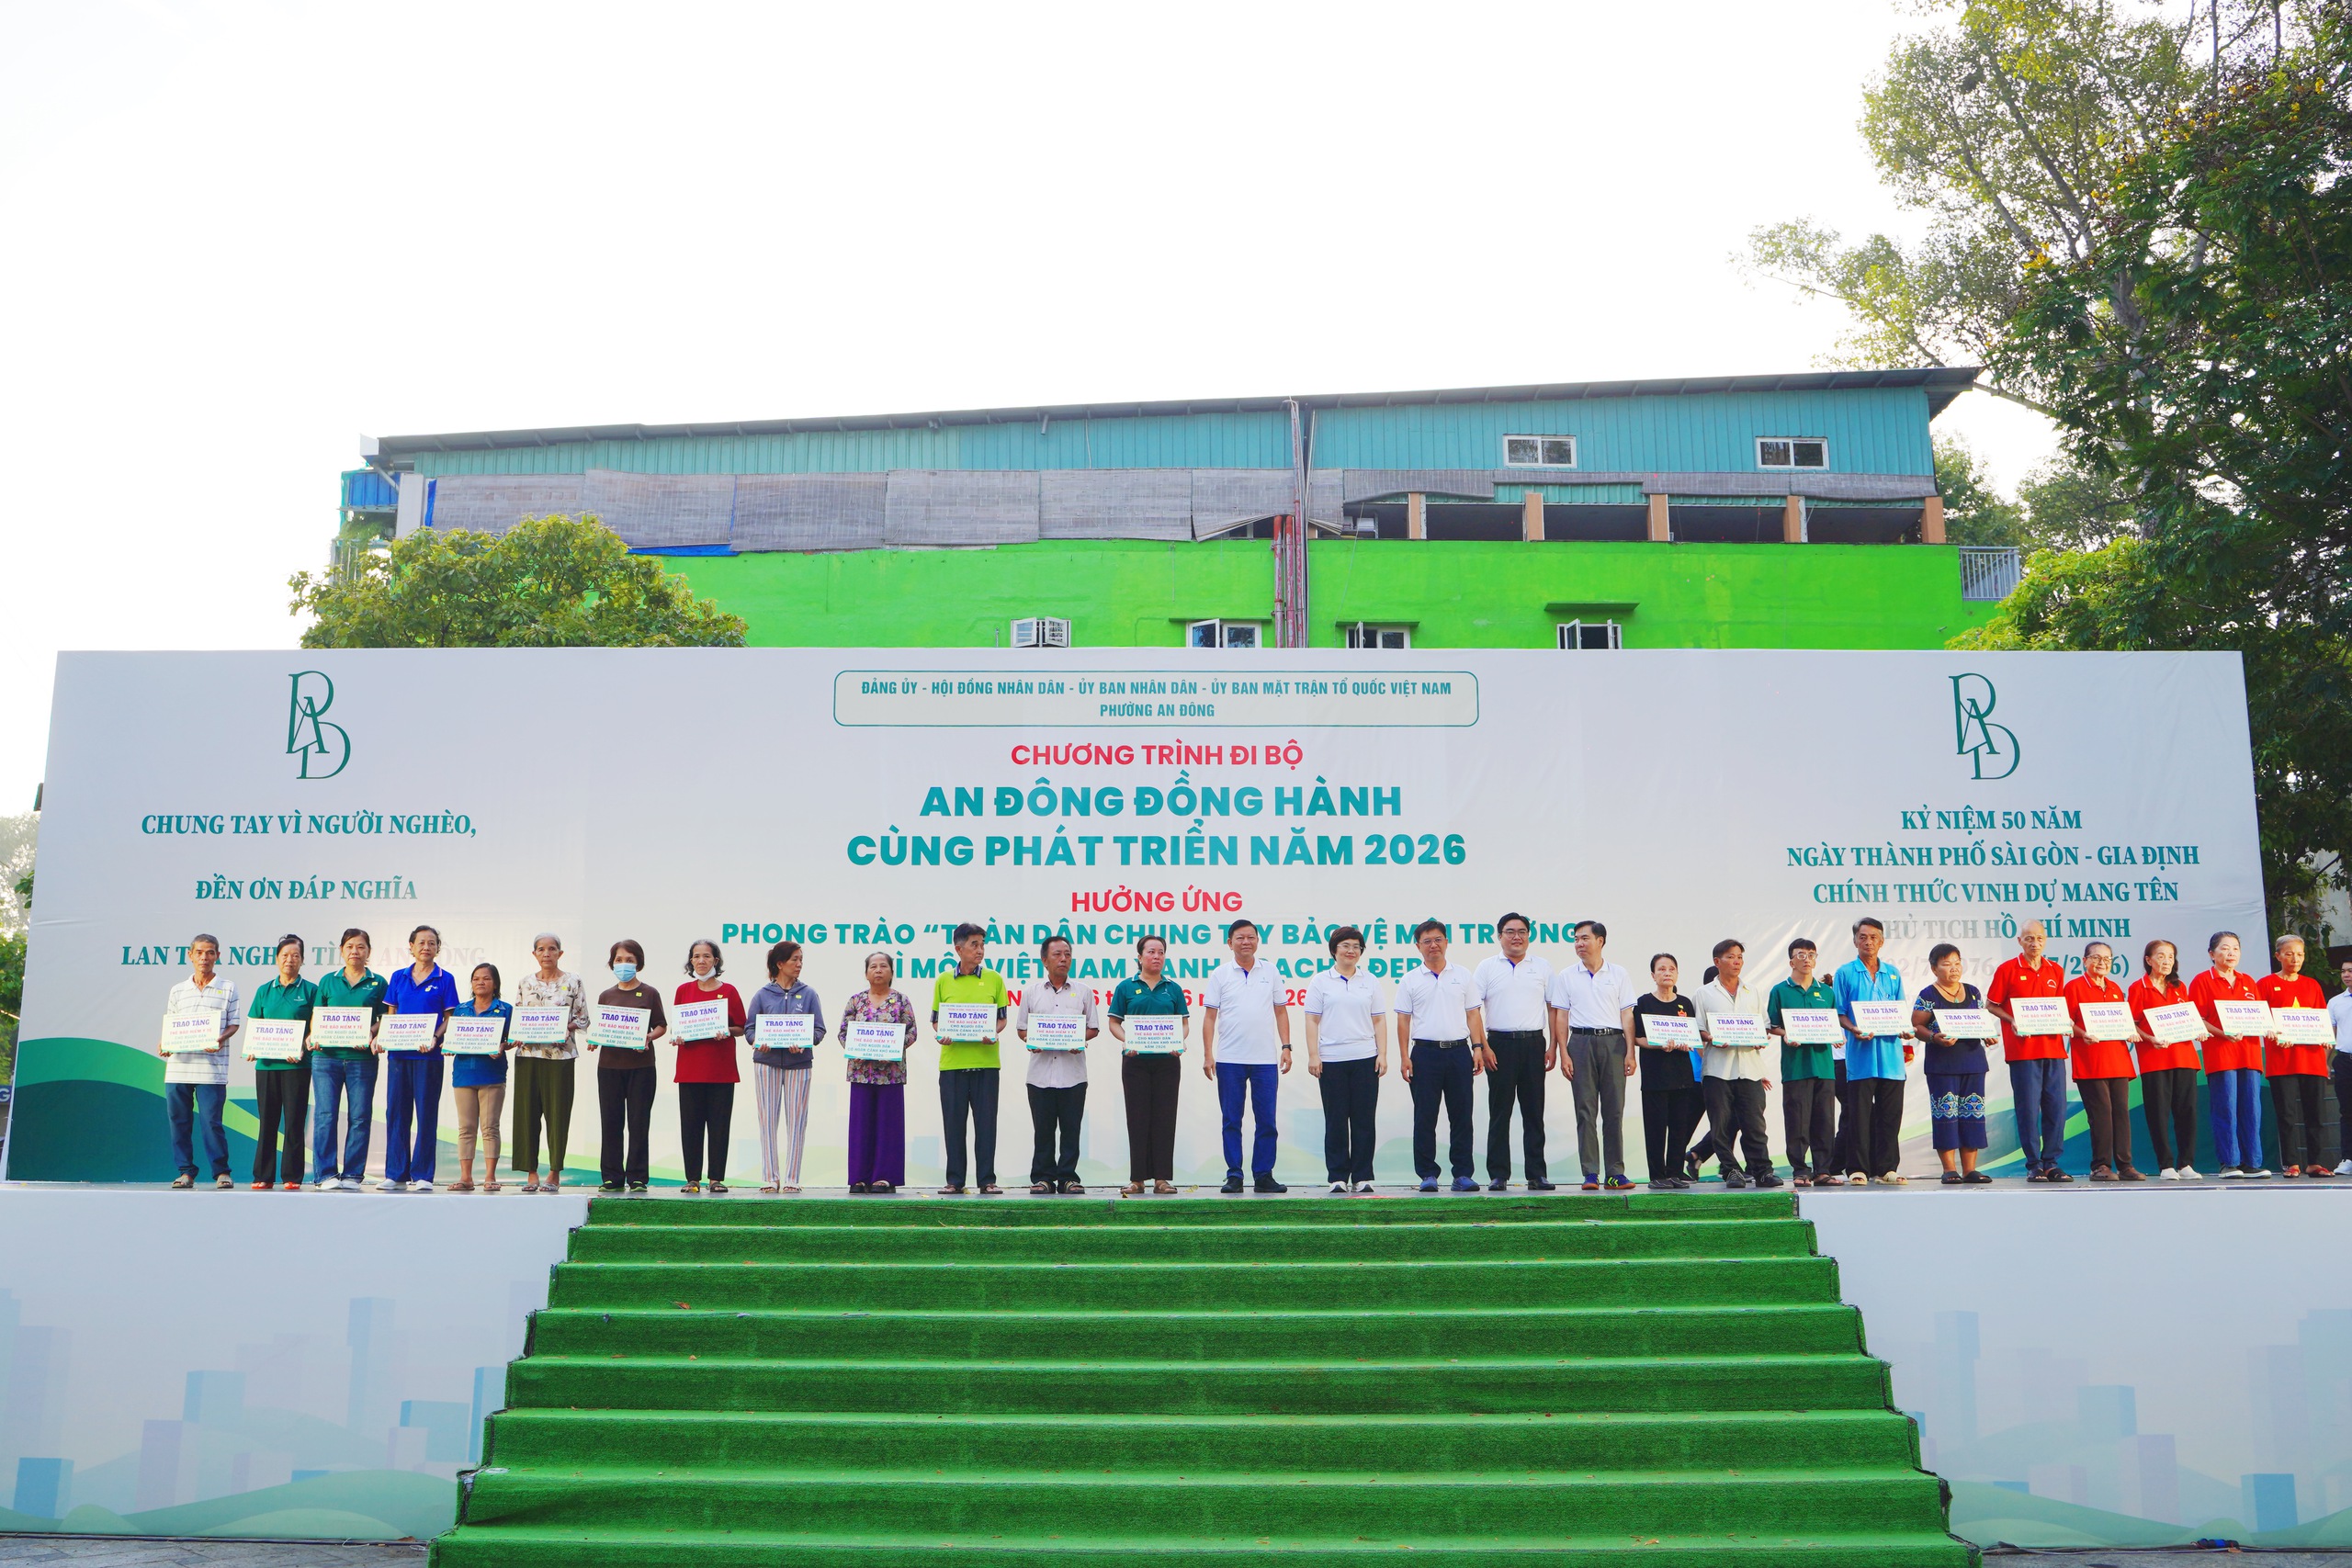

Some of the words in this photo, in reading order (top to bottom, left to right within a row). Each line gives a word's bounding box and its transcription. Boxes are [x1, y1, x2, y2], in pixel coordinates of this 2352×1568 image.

[862, 678, 897, 694] ĐẢNG
[901, 678, 917, 694] ỦY
[932, 680, 953, 696] HỘI
[957, 678, 992, 694] ĐỒNG
[998, 680, 1034, 694] NHÂN
[1038, 680, 1064, 694] DÂN
[1079, 678, 1094, 694] ỦY
[1100, 682, 1125, 694] BAN
[1130, 680, 1166, 694] NHÂN
[1170, 680, 1196, 694] DÂN
[1211, 678, 1227, 694] ỦY
[1232, 682, 1258, 694] BAN
[1262, 680, 1289, 697] MẶT
[1295, 680, 1328, 697] TRẬN
[1332, 677, 1348, 694] TỔ
[1351, 678, 1385, 695] QUỐC
[1390, 680, 1418, 697] VIỆT
[1421, 682, 1452, 694] NAM
[1100, 701, 1153, 716] PHƯỜNG
[1158, 704, 1175, 716] AN
[1180, 702, 1216, 716] ĐÔNG
[1012, 743, 1134, 765] CHƯƠNG
[1141, 738, 1223, 765] TRÌNH
[1230, 746, 1257, 765] ĐI
[1266, 740, 1304, 770] BỘ
[921, 786, 984, 816] AN
[994, 777, 1125, 817] ĐÔNG
[1134, 770, 1263, 817] ĐỒNG
[1275, 775, 1401, 816] HÀNH
[141, 815, 224, 835] CHUNG
[230, 815, 273, 834] TAY
[278, 810, 301, 834] VÌ
[308, 810, 383, 834] NGƯỜI
[390, 810, 477, 838] NGHÈO,
[1902, 805, 1930, 829] KỶ
[1937, 805, 1996, 835] NIỆM
[2002, 811, 2026, 829] 50
[2031, 806, 2082, 829] NĂM
[847, 825, 974, 866] CÙNG
[986, 825, 1102, 865] PHÁT
[1114, 818, 1238, 865] TRIỂN
[1251, 827, 1353, 865] NĂM
[1365, 834, 1466, 865] 2026
[1787, 842, 1845, 866] NGÀY
[1850, 842, 1932, 866] THÀNH
[1939, 840, 1986, 866] PHỐ
[1992, 841, 2027, 866] SÀI
[2032, 841, 2079, 866] GÒN
[2098, 846, 2137, 865] GIA
[2142, 846, 2199, 871] ĐỊNH
[196, 874, 243, 899] ĐỀN
[249, 878, 283, 899] ƠN
[289, 874, 334, 899] ĐÁP
[341, 874, 418, 900] NGHĨA
[1072, 886, 1174, 912] HƯỞNG
[1182, 885, 1243, 912] ỨNG
[1813, 878, 1889, 903] CHÍNH
[1894, 877, 1957, 903] THỨC
[1961, 884, 2020, 903] VINH
[2024, 879, 2057, 908] DỰ
[2062, 882, 2130, 903] MANG
[2133, 877, 2178, 902] TÊN
[722, 923, 828, 944] PHONG
[834, 917, 915, 944] TRÀO
[924, 917, 1025, 945] “TÀN
[1033, 918, 1097, 944] DÂN
[1104, 924, 1211, 944] CHUNG
[1218, 924, 1274, 944] TY
[1351, 917, 1388, 950] VỆ
[1396, 917, 1453, 944] MI
[1883, 913, 1917, 940] HỦ
[1984, 910, 2018, 939] HỒ
[2044, 913, 2061, 938] HÍ
[2069, 919, 2132, 938] MINH
[121, 946, 170, 965] LAN
[439, 942, 486, 966] ÔNG
[986, 952, 1044, 985] VIỆT
[1135, 959, 1220, 979] ANH
[1261, 958, 1336, 984] ẠCH
[255, 1026, 274, 1034] TRAO
[601, 1013, 619, 1021] TRAO
